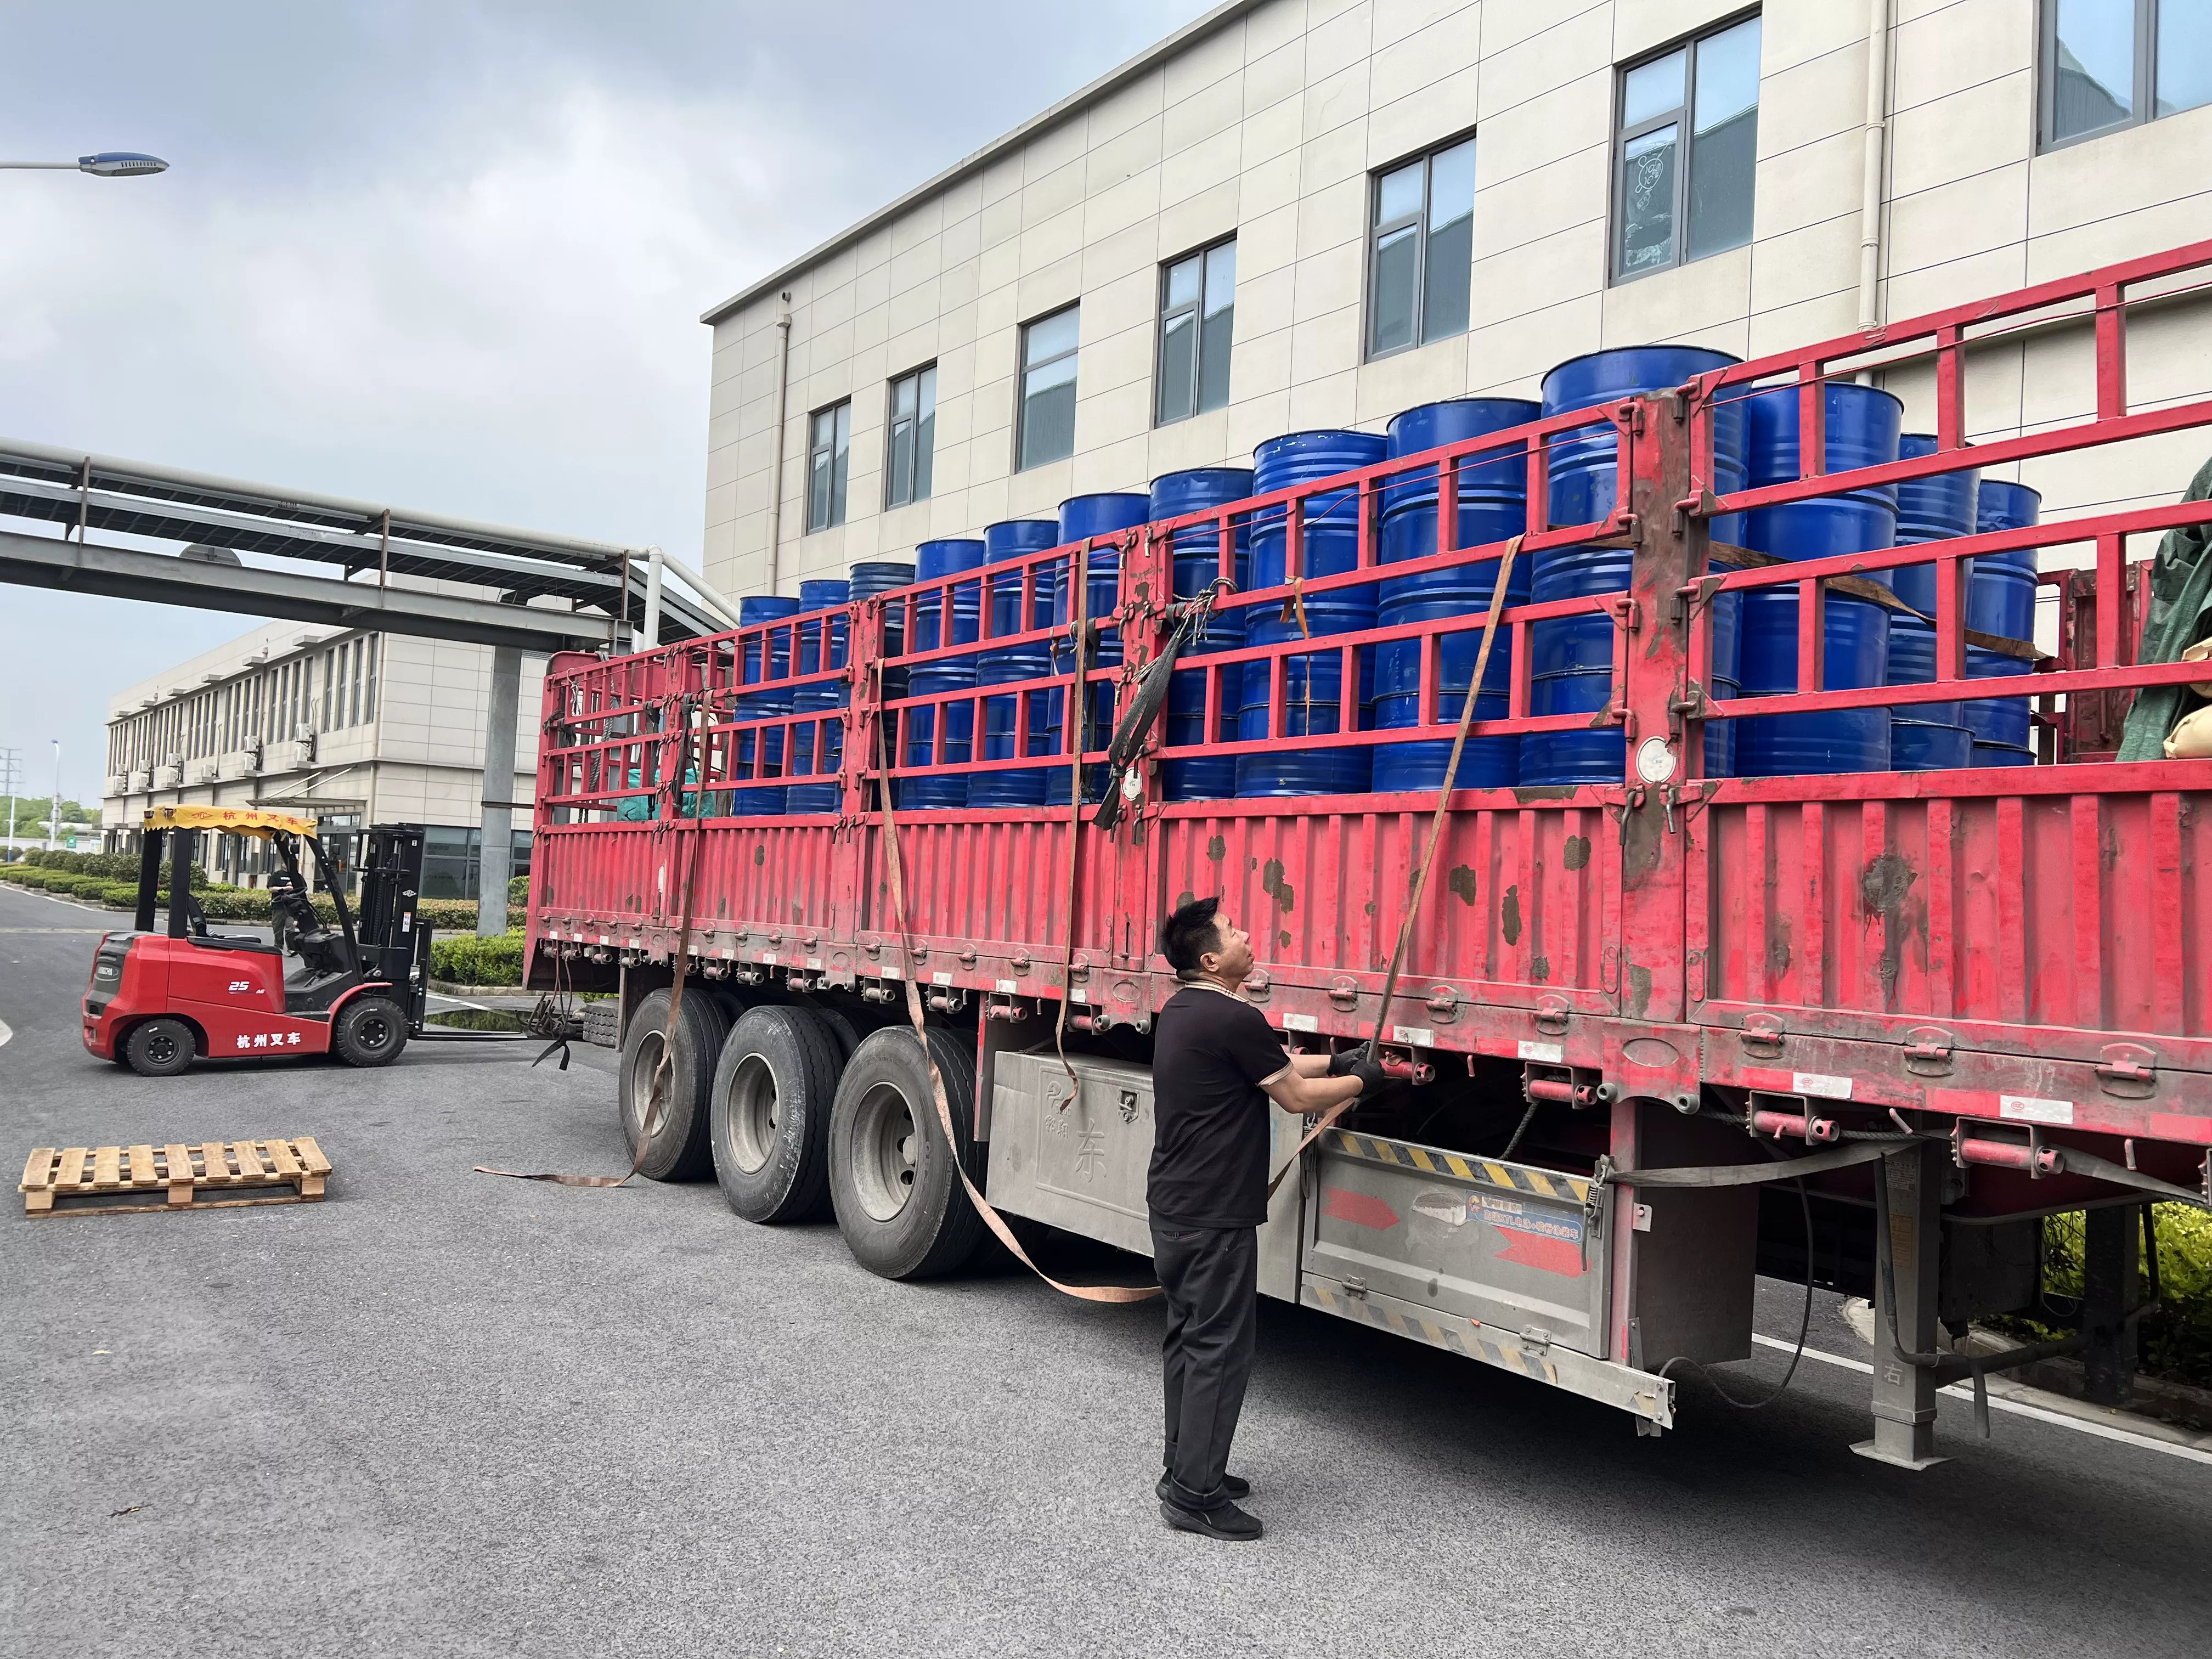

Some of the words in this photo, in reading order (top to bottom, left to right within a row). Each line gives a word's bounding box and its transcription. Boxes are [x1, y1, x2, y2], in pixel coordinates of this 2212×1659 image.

[223, 811, 298, 825] 杭州叉车
[228, 981, 250, 991] 25
[236, 1031, 301, 1048] 杭州叉车
[1075, 1118, 1107, 1183] 东
[1884, 1363, 1903, 1385] 右
